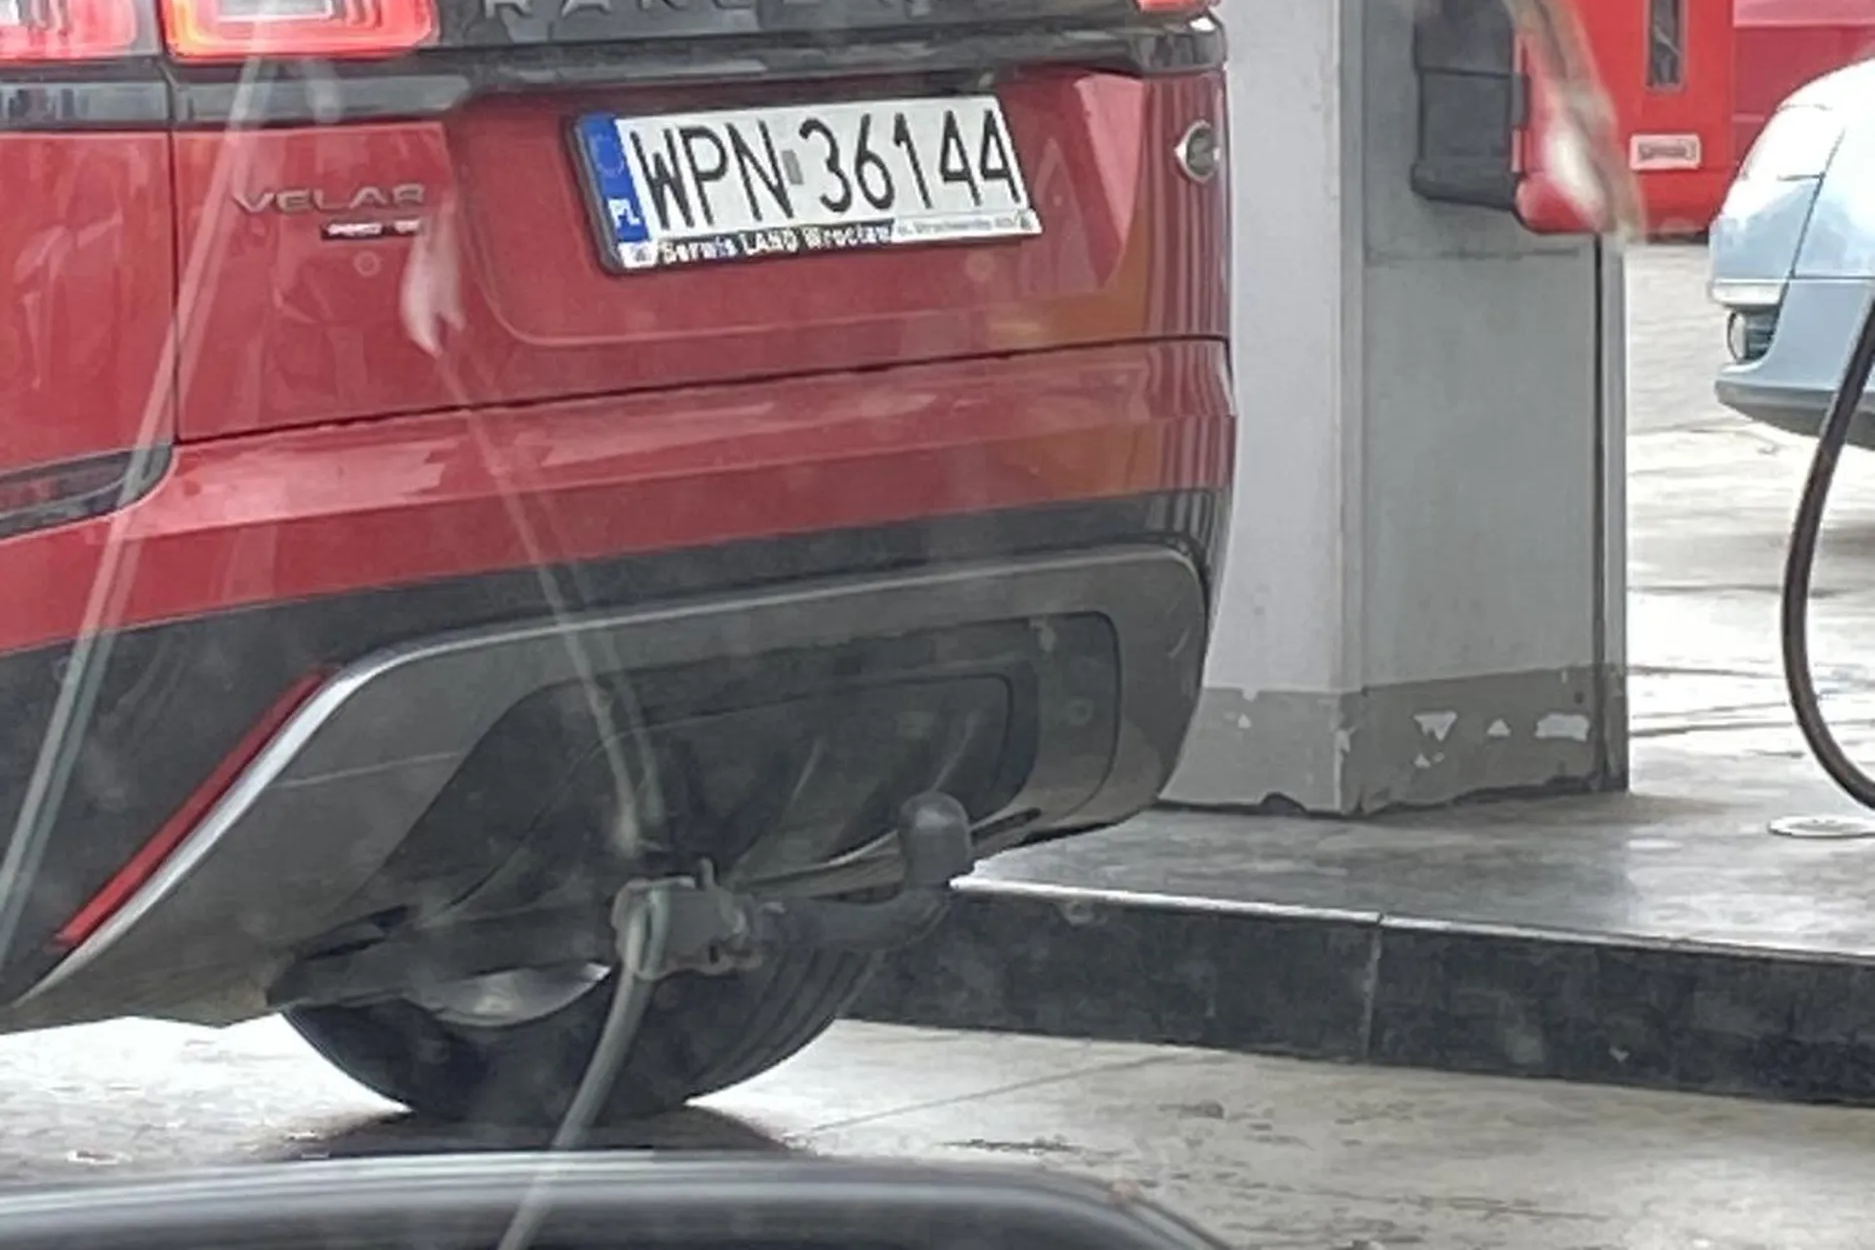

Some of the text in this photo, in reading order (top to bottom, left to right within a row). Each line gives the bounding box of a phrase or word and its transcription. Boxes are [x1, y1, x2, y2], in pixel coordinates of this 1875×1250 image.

[629, 109, 1022, 230] WPN 36144
[233, 183, 424, 214] VELAR
[608, 197, 643, 228] PL
